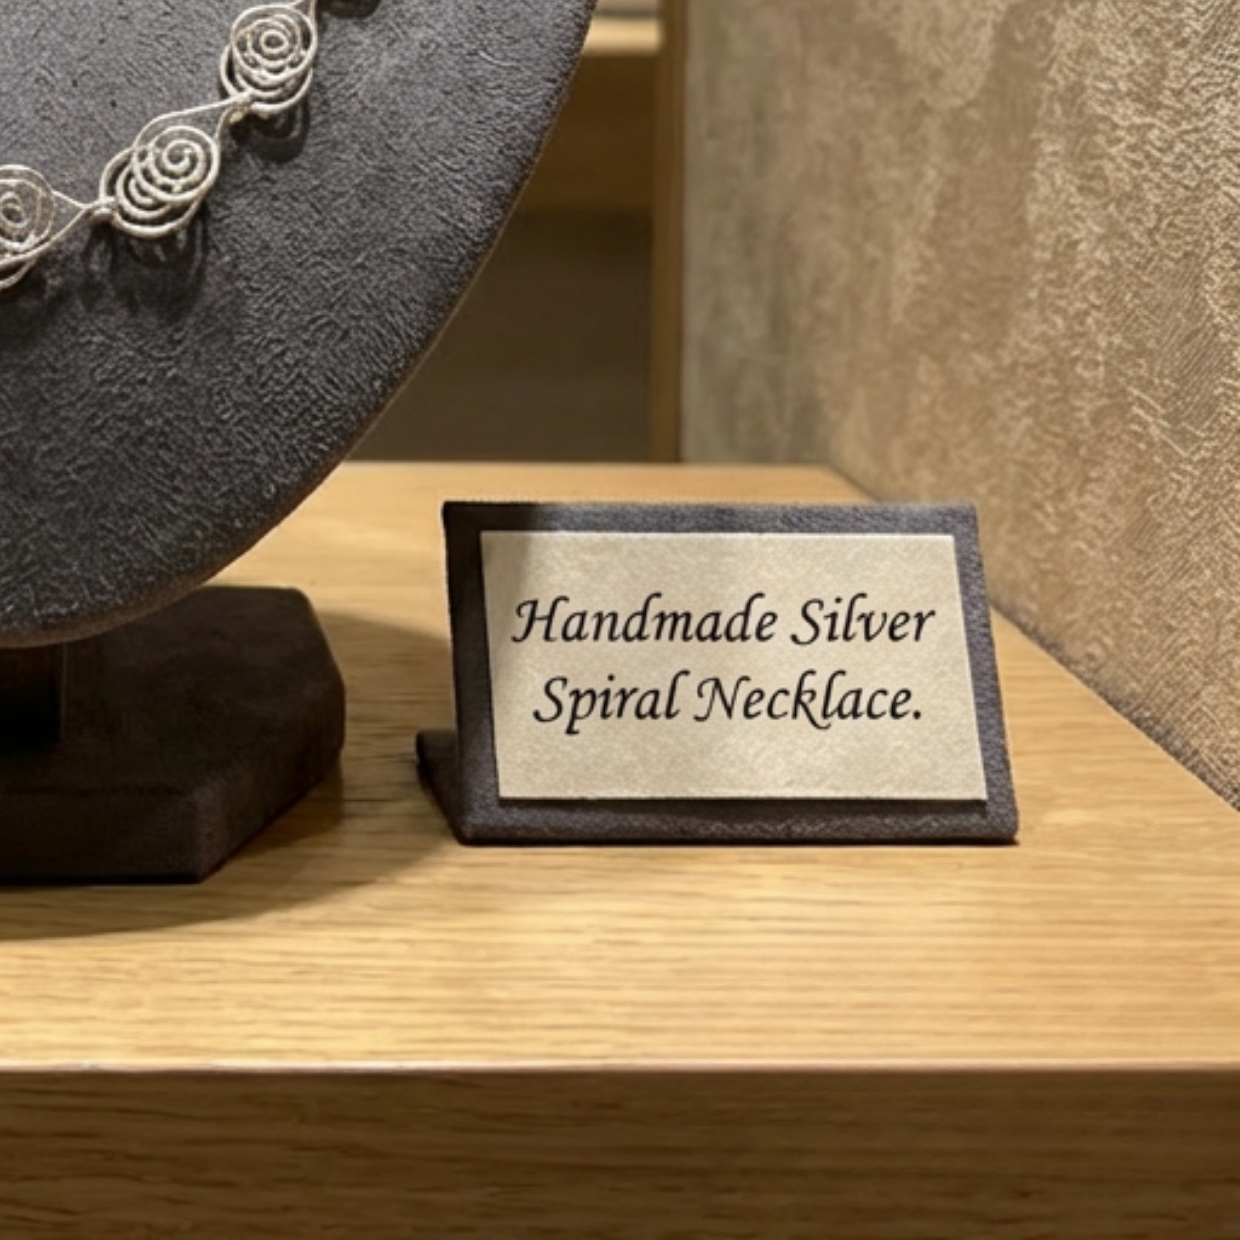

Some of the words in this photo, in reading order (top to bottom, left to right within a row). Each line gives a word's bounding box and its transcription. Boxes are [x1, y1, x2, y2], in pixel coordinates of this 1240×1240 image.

[510, 591, 778, 644] Handmade
[790, 592, 936, 645] Silver
[532, 669, 691, 736] Spiral
[693, 669, 922, 730] Necklace.
